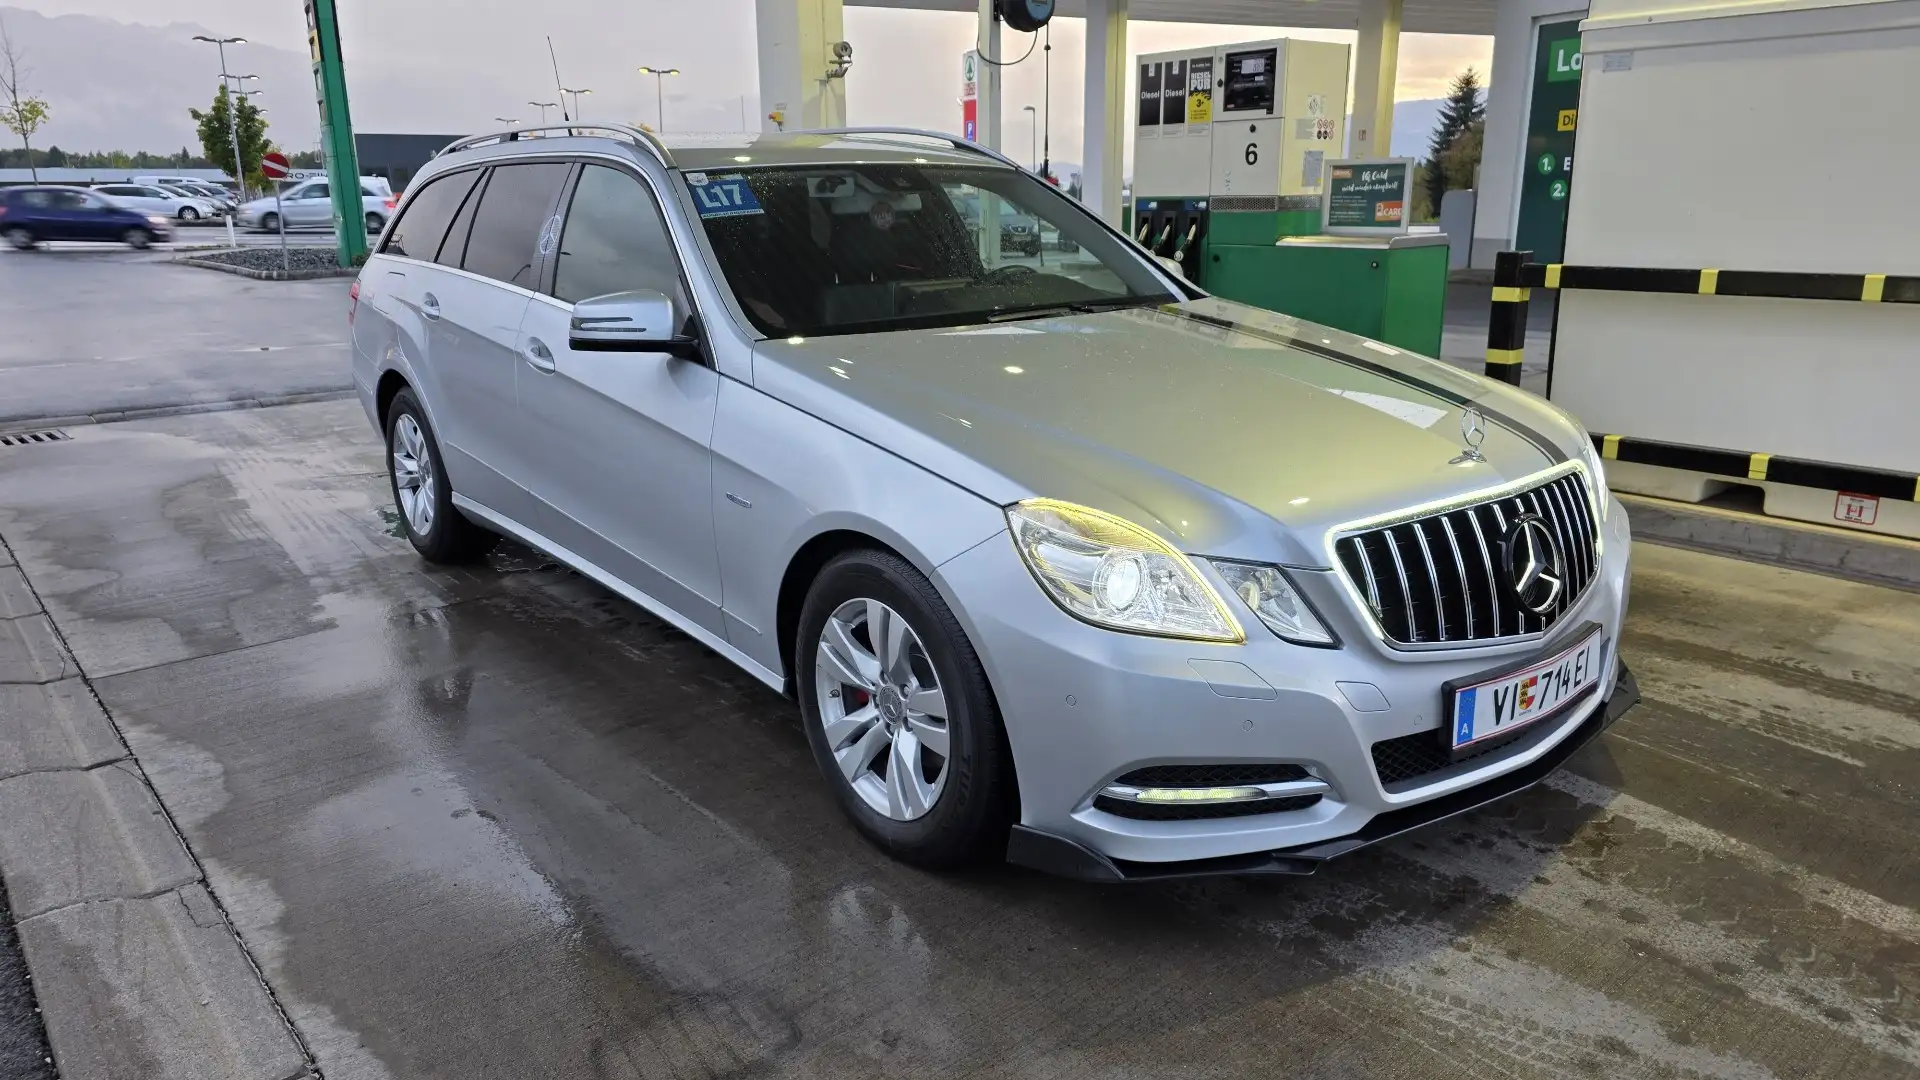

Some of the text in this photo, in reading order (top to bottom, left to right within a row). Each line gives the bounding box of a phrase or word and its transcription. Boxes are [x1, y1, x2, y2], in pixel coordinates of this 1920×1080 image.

[1190, 71, 1211, 80] DIESEL
[1190, 79, 1211, 91] PUR
[1141, 90, 1160, 99] Diesel
[1165, 88, 1185, 97] Diesel
[1245, 143, 1258, 166] 6
[1542, 157, 1551, 171] 1.
[1372, 168, 1389, 181] Card
[695, 184, 743, 208] L17
[1552, 183, 1565, 197] 2.
[1493, 646, 1590, 726] VI 714 EI
[1460, 722, 1469, 736] A
